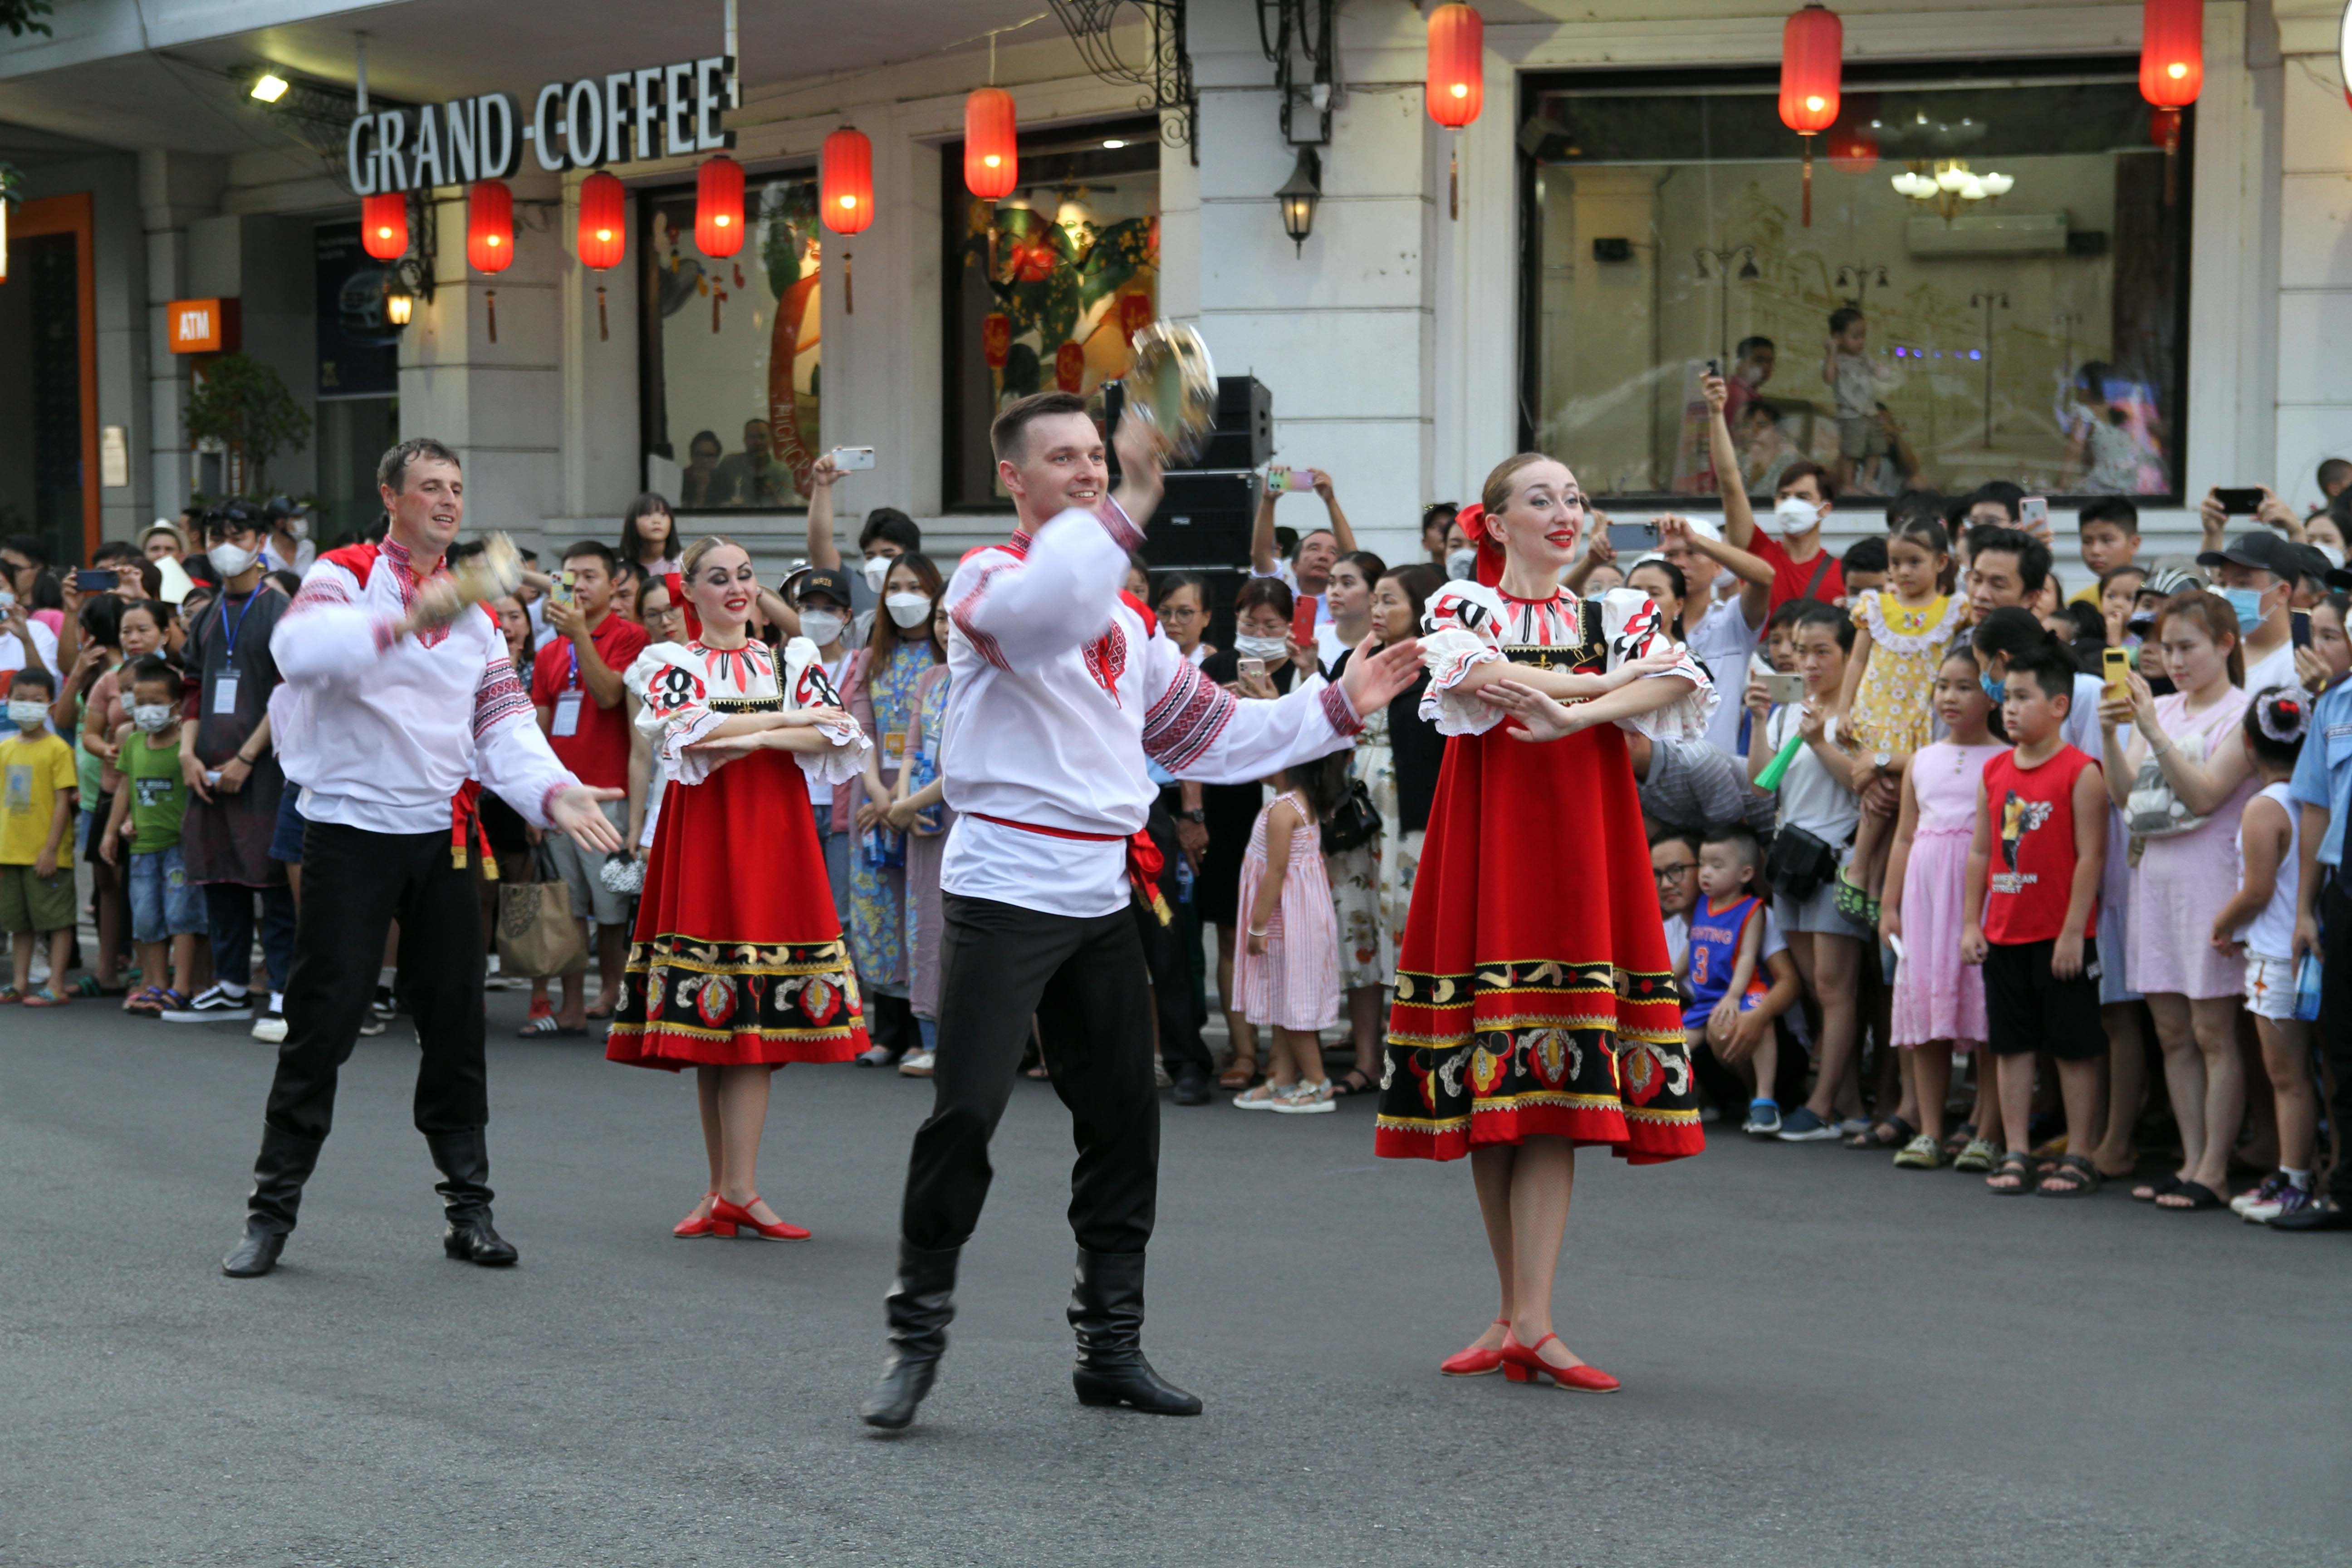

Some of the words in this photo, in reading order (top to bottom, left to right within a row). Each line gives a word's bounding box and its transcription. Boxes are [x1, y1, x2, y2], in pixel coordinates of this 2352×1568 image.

[348, 93, 515, 196] GRAND
[534, 56, 727, 172] COFFEE
[179, 309, 211, 341] ATM
[1692, 946, 1709, 985] 3
